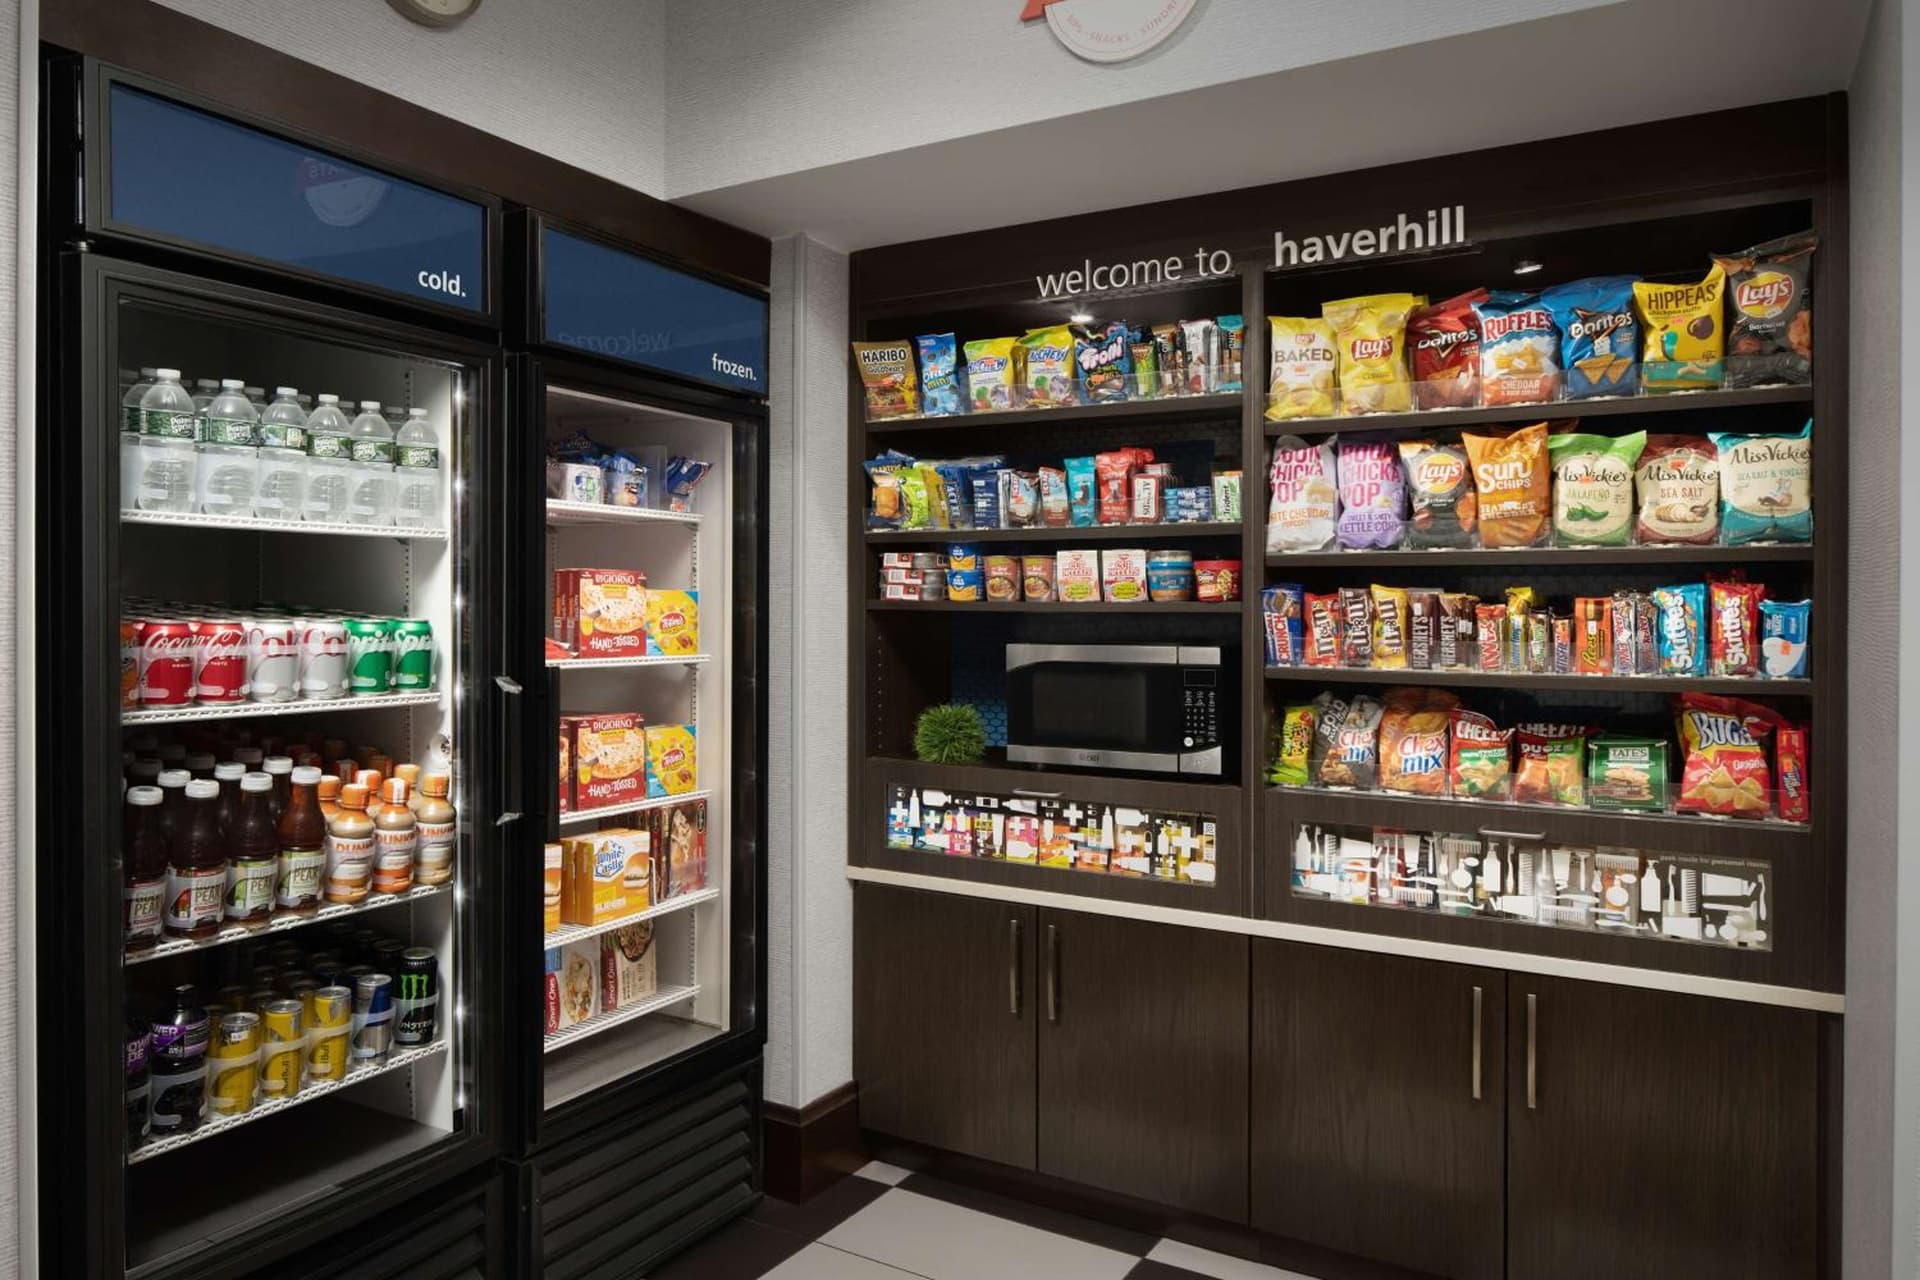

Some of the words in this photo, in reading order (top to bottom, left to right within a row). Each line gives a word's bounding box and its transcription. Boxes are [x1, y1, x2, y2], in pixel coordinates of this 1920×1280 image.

[1036, 255, 1183, 298] welcome
[1194, 246, 1232, 277] to
[1273, 205, 1465, 267] haverhill
[416, 267, 468, 298] cold.
[1647, 283, 1716, 310] HIPPEAS
[1484, 310, 1552, 342] RUFFLES
[1570, 311, 1633, 338] Doritos
[1355, 337, 1392, 360] Lay's
[1417, 327, 1479, 350] Doritos
[861, 348, 907, 363] HARIBO
[1079, 334, 1123, 371] Trolli
[1274, 348, 1334, 364] BAKED
[711, 352, 758, 381] frozen.
[1501, 379, 1541, 390] CHEDDAR
[1730, 447, 1767, 465] Miss
[1477, 460, 1532, 494] Sun
[1496, 478, 1532, 490] CHIPS
[1643, 465, 1677, 481] Miss
[1677, 468, 1720, 486] Vickie's
[1660, 486, 1678, 498] SEA
[1681, 486, 1704, 498] SALT
[1273, 613, 1290, 665] CRUNCH
[1664, 593, 1694, 670] Skittles
[1722, 596, 1748, 667] Skittles
[593, 718, 633, 730] DIGIORNO
[1397, 731, 1446, 757] Chex
[595, 859, 624, 874] Castle
[597, 849, 623, 864] White
[549, 1001, 557, 1029] Smart
